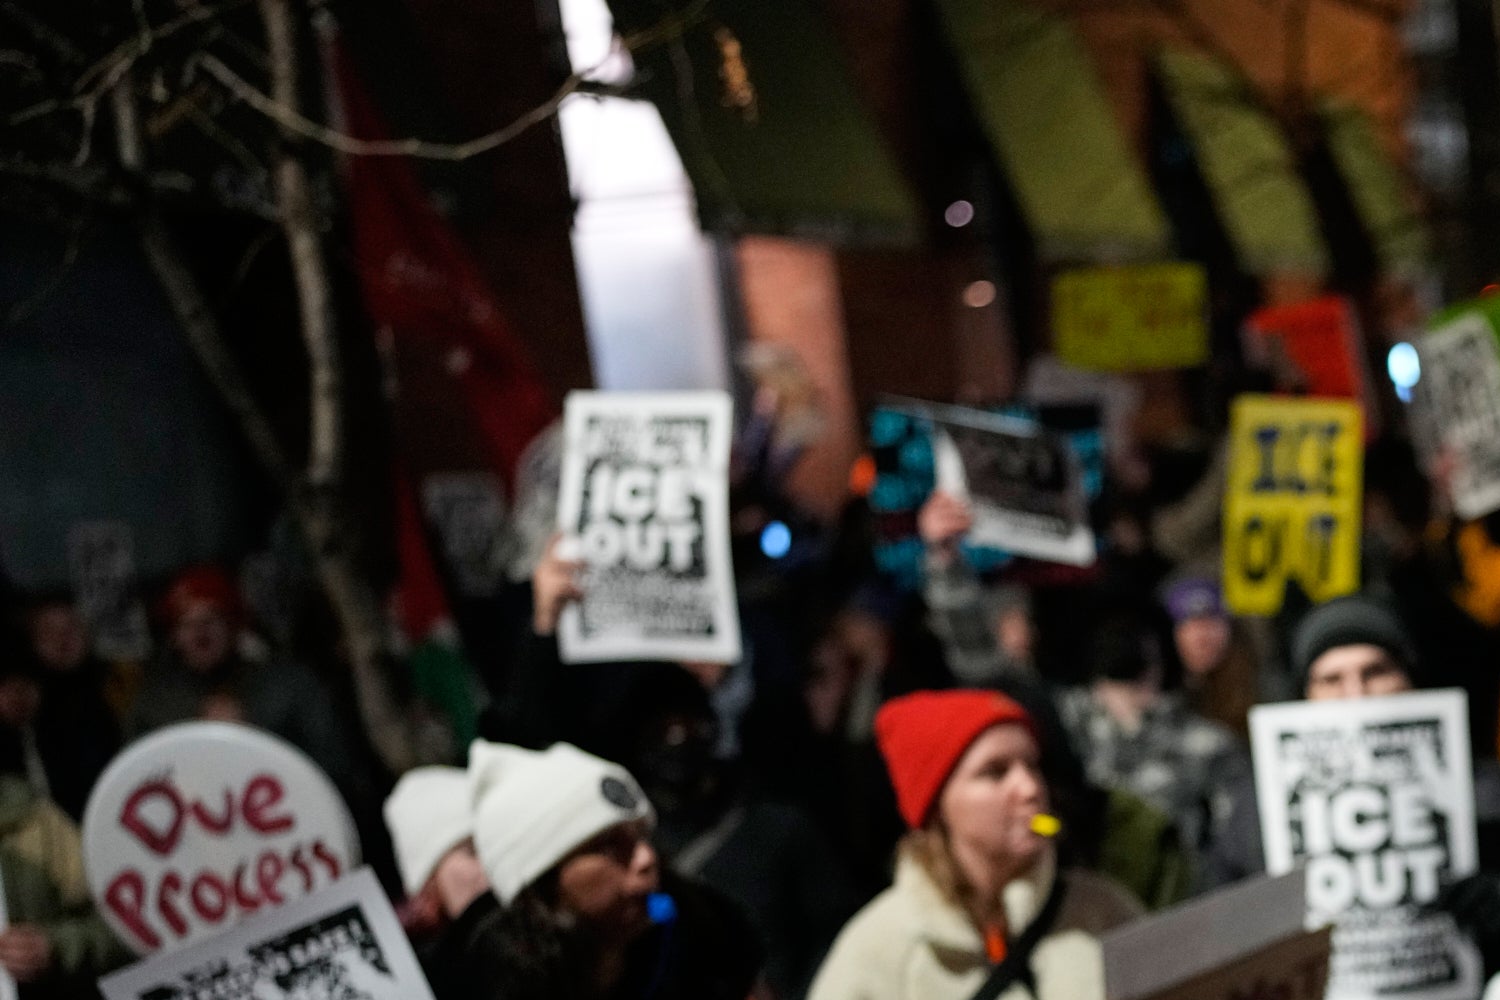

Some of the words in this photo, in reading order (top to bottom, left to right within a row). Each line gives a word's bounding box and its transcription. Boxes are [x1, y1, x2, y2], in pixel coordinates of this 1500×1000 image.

[588, 460, 697, 524] ICE
[580, 520, 698, 571] OUT
[118, 772, 293, 857] Due
[1301, 782, 1438, 850] ICE
[104, 838, 341, 954] Process
[1304, 846, 1444, 907] OUT
